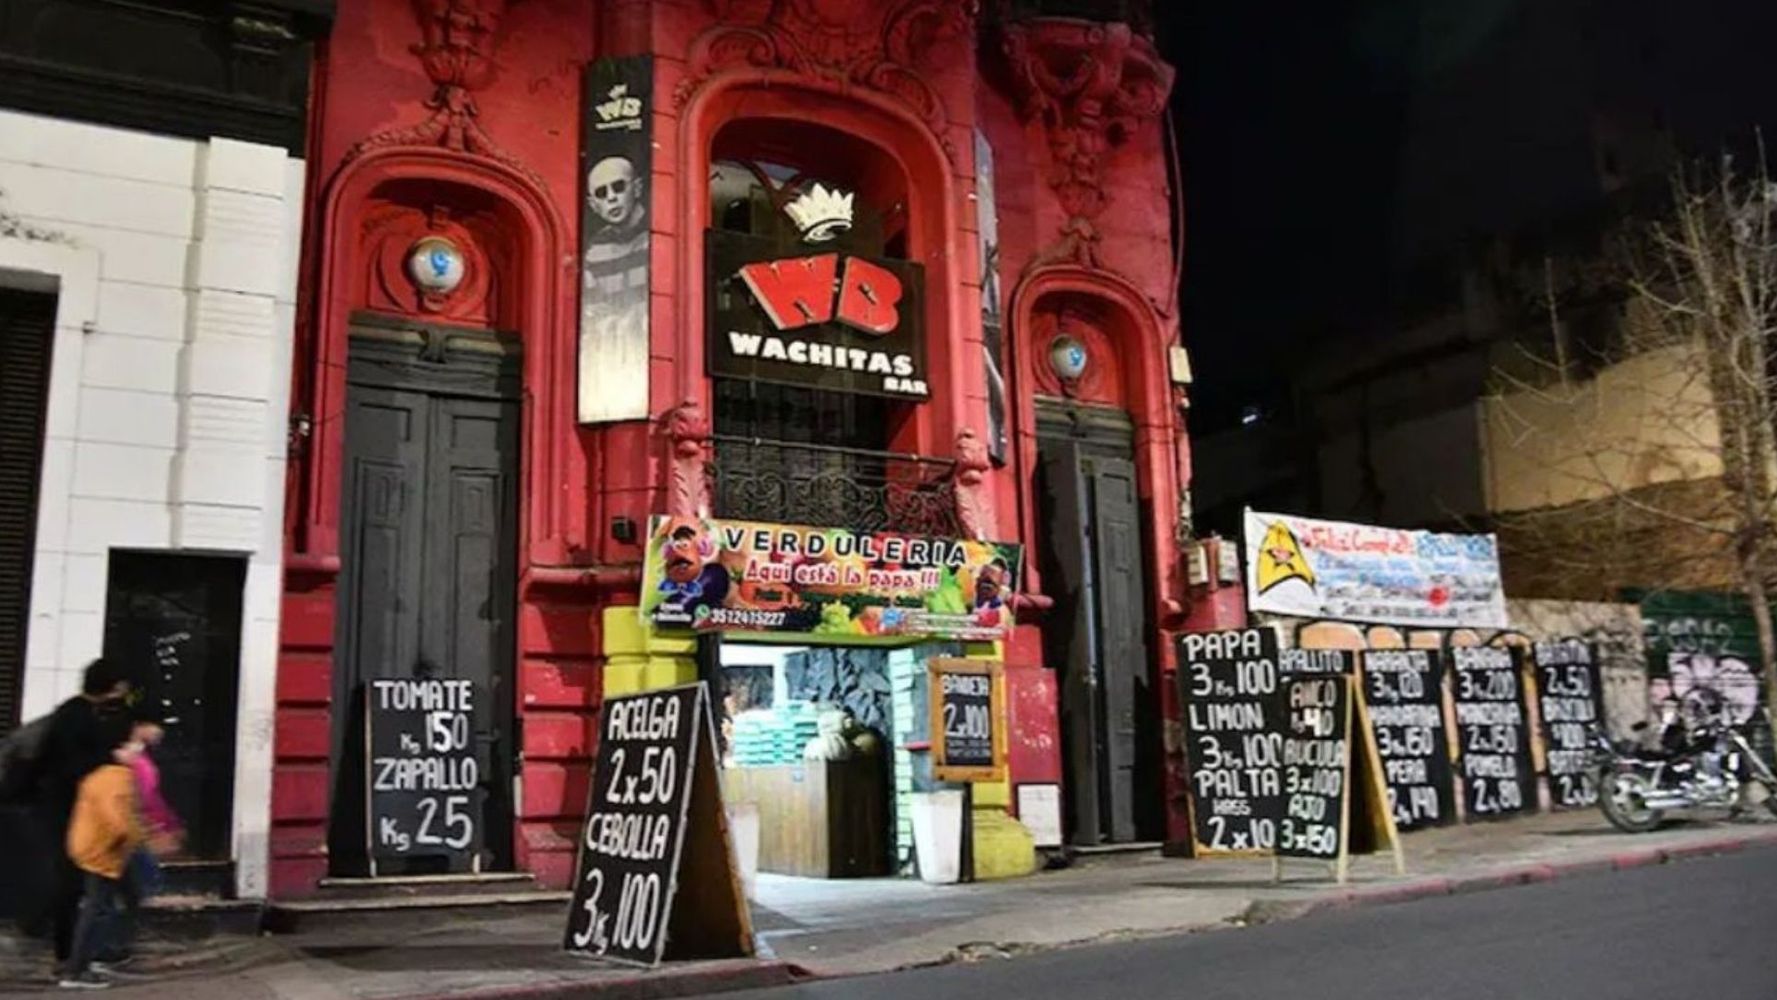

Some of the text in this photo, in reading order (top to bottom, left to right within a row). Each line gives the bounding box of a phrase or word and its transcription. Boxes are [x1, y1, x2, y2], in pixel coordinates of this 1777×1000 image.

[595, 97, 641, 121] WB
[740, 252, 903, 334] WB
[729, 331, 914, 376] WACHITAS
[883, 376, 928, 396] BAR
[724, 527, 969, 566] VERDULERIA
[795, 563, 837, 584] está
[845, 565, 863, 585] la
[868, 570, 915, 589] papa
[1182, 629, 1261, 662] PAPA
[1235, 658, 1276, 696] 100
[373, 680, 473, 711] TOMATE
[425, 711, 468, 752] 150
[608, 694, 681, 741] ACELGA
[1188, 702, 1265, 732] LIMON
[373, 757, 478, 791] ZAPALLO
[606, 746, 676, 804] 2x50
[1193, 767, 1280, 798] PALTA
[1385, 758, 1429, 785] PERA
[415, 795, 474, 849] 25
[1288, 793, 1327, 821] AJO
[586, 812, 670, 860] CEBOLLA
[610, 871, 661, 950] 100
